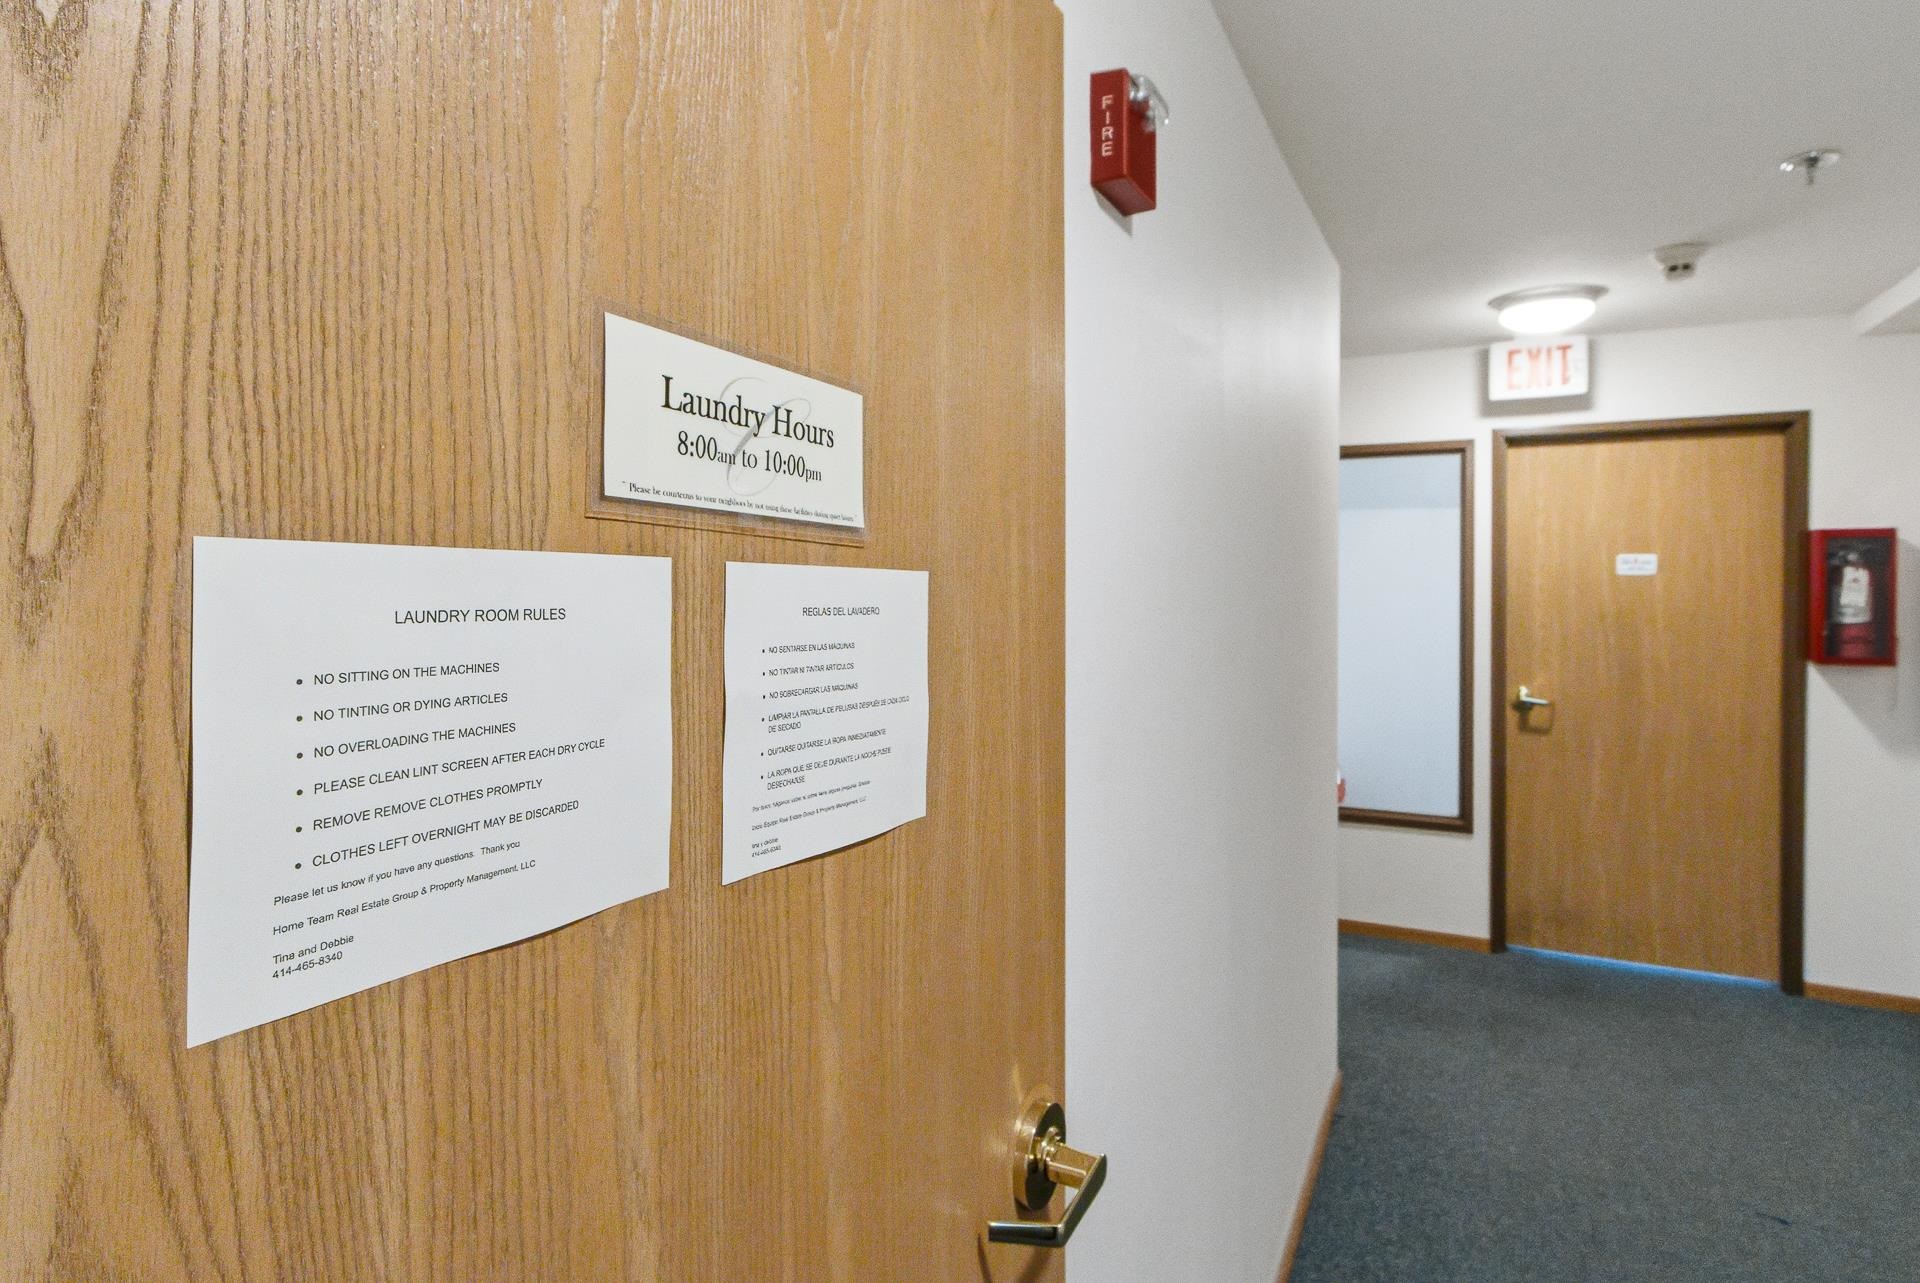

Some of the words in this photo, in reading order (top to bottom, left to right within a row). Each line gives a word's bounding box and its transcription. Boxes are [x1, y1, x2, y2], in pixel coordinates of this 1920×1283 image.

[1102, 95, 1114, 157] FIRE
[1506, 343, 1574, 390] EXIT
[661, 375, 766, 436] Laundry
[772, 405, 834, 448] Hours
[677, 431, 736, 466] 8:00am
[742, 449, 758, 469] to
[765, 449, 822, 482] 10:00pm
[395, 610, 470, 624] LAUNDRY
[475, 609, 519, 622] ROOM
[523, 608, 566, 621] RULES
[803, 607, 831, 616] REGLAS
[833, 607, 846, 616] DEL
[848, 606, 880, 615] LAVADERO
[779, 645, 807, 653] SENTARSE
[314, 673, 334, 685] NO
[338, 670, 389, 684] SITTING
[392, 668, 410, 679] ON
[414, 666, 437, 677] THE
[440, 662, 500, 676] MACHINES
[780, 667, 798, 675] TINTAR
[780, 687, 819, 698] SOBRECARGAR
[821, 685, 830, 693] LAS
[314, 709, 334, 722] NO
[338, 703, 389, 719] TINTING
[393, 701, 410, 713] OR
[414, 697, 451, 711] DYING
[454, 692, 508, 707] ARTICLES
[800, 708, 826, 717] PANTALLA
[314, 745, 334, 758] NO
[338, 732, 428, 755] OVERLOADING
[432, 729, 455, 743] THE
[458, 722, 516, 739] MACHINES
[768, 725, 776, 733] DE
[778, 722, 801, 732] SECADO
[768, 744, 796, 756] QUITARSE
[797, 739, 824, 751] QUITARSE
[314, 776, 365, 794] PLEASE
[369, 769, 410, 785] CLEAN
[413, 764, 438, 779] LINT
[442, 757, 488, 773] SCREEN
[492, 751, 526, 766] AFTER
[528, 747, 555, 761] EACH
[558, 743, 577, 756] DRY
[578, 738, 605, 752] CYCLE
[768, 771, 776, 779] LA
[793, 764, 805, 773] QUE
[829, 755, 853, 765] DURANTE
[313, 809, 370, 831] REMOVE
[374, 799, 426, 818] REMOVE
[430, 789, 484, 807] CLOTHES
[487, 778, 543, 798] PROMPTLY
[312, 843, 375, 868] CLOTHES
[379, 836, 409, 852] LEFT
[412, 821, 480, 845] OVERNIGHT
[484, 816, 506, 831] MAY
[509, 812, 522, 824] BE
[526, 800, 579, 821] DISCARDED
[274, 890, 309, 906] Please
[312, 885, 324, 898] let
[327, 882, 338, 893] us
[341, 875, 366, 889] know
[368, 872, 374, 883] if
[376, 870, 392, 882] you
[394, 863, 415, 877] have
[418, 861, 432, 872] any
[481, 843, 504, 857] Thank
[507, 841, 520, 851] you
[273, 921, 304, 935] Home
[307, 913, 334, 927] Team
[337, 905, 359, 918] Real
[362, 896, 389, 912] Estate
[392, 889, 418, 905] Group
[421, 886, 428, 895] &
[430, 877, 464, 895] Property
[521, 859, 536, 872] LLC
[273, 951, 295, 965] Tina
[298, 944, 317, 958] and
[320, 933, 354, 951] Debbie
[272, 950, 343, 979] 414-465-8340
